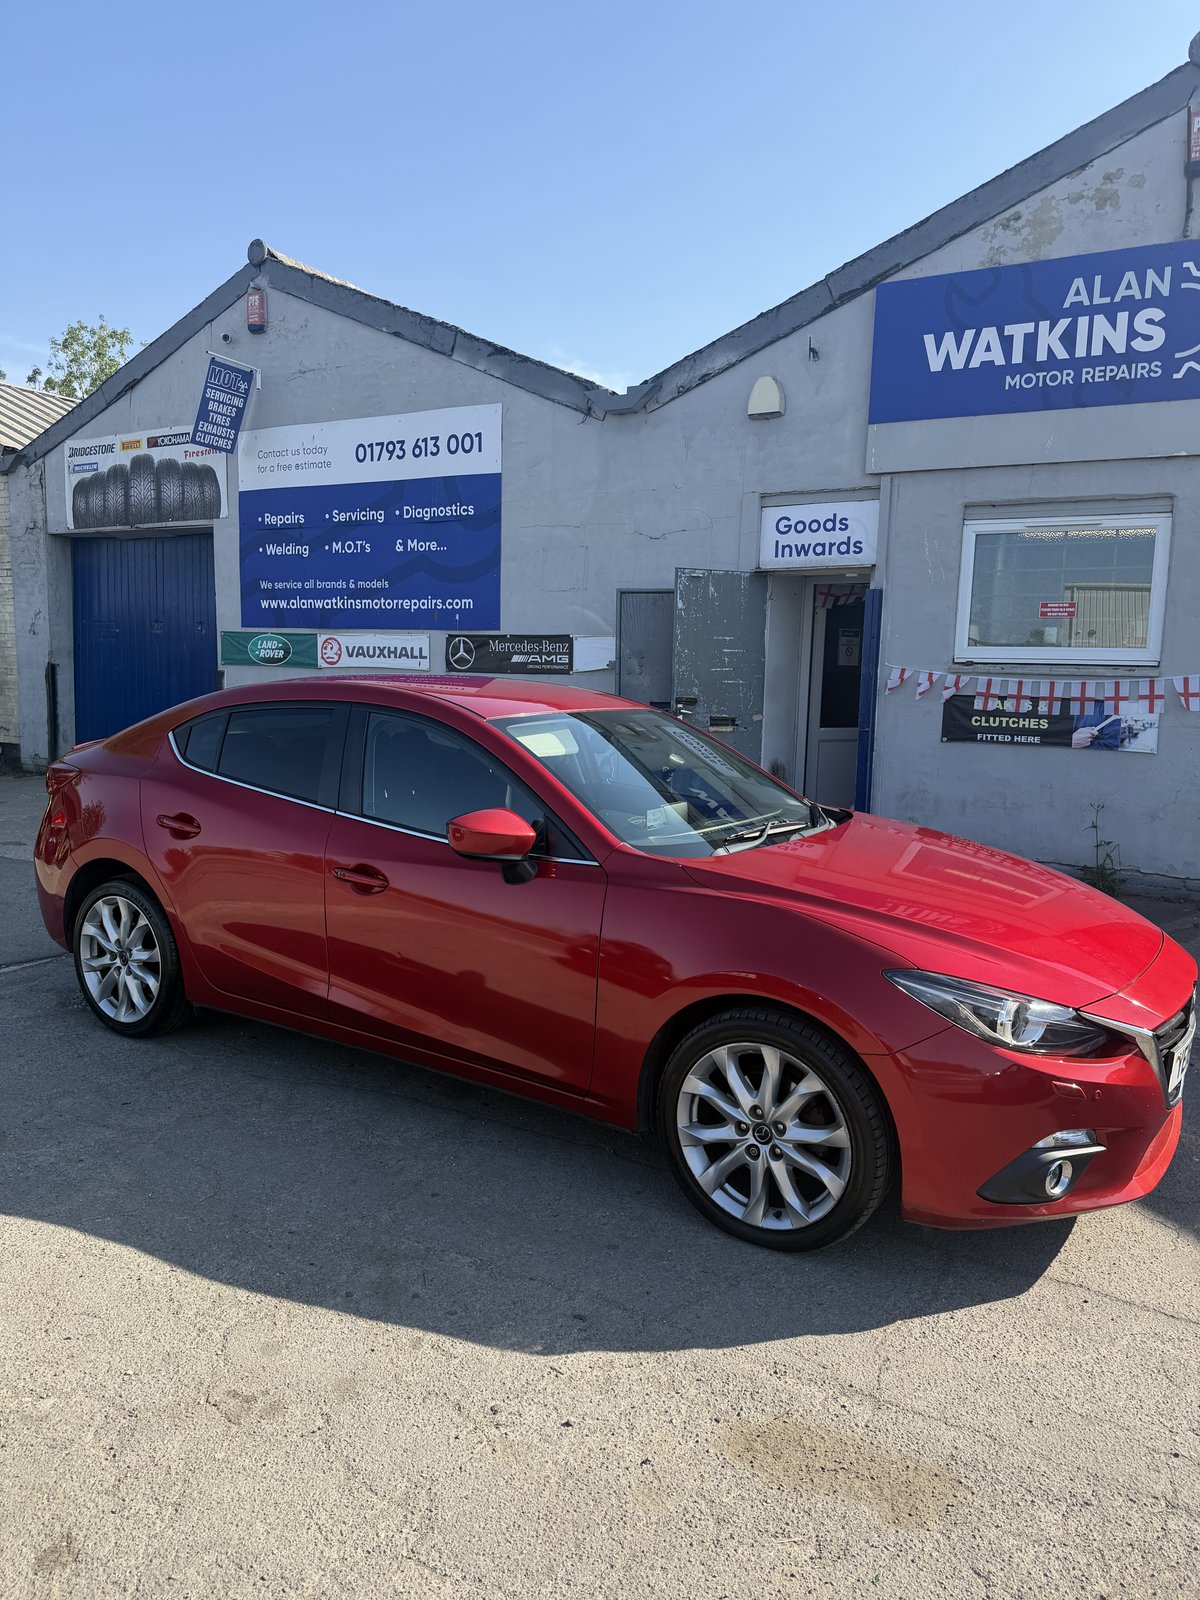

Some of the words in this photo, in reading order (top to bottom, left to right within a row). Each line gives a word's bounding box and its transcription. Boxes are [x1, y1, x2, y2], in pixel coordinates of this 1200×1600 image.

[1062, 266, 1172, 309] ALAN
[923, 307, 1167, 373] WATKINS
[207, 365, 241, 390] MOT
[1005, 369, 1074, 390] MOTOR
[1081, 361, 1163, 384] REPAIRS
[205, 388, 244, 408] SERVICING
[208, 400, 237, 417] BRAKES
[209, 412, 231, 427] TYRES
[198, 421, 235, 439] EXHAUSTS
[68, 443, 116, 458] BRIDGESTONE
[157, 434, 190, 446] YOKOHAMA
[195, 432, 233, 450] CLUTCHES
[355, 440, 406, 463] 01793
[411, 436, 440, 459] 613
[446, 432, 483, 455] 001
[257, 448, 289, 460] Contact
[290, 448, 300, 457] us
[302, 445, 329, 458] today
[257, 463, 268, 474] for
[269, 465, 275, 473] a
[276, 462, 293, 472] free
[294, 460, 332, 471] estimate
[264, 512, 305, 527] Repairs
[332, 507, 385, 523] Servicing
[403, 503, 475, 520] Diagnostics
[775, 513, 849, 535] Goods
[266, 543, 310, 557] Welding
[395, 539, 404, 552] &
[408, 539, 447, 552] More...
[774, 536, 864, 559] Inwards
[260, 580, 273, 589] We
[274, 580, 302, 589] service
[304, 579, 315, 589] all
[316, 579, 347, 589] brands
[349, 580, 355, 589] &
[357, 579, 389, 589] models
[260, 596, 474, 613] www.alanwatkinsmotorrepairs.com
[257, 640, 277, 649] LAND
[489, 639, 569, 653] Mercedes-Benz
[259, 650, 285, 659] ROVER
[345, 646, 428, 660] VAUXHALL
[527, 655, 569, 663] AMG
[971, 716, 1049, 729] CLUTCHES
[977, 733, 1011, 742] FITTED
[1014, 735, 1041, 744] HERE
